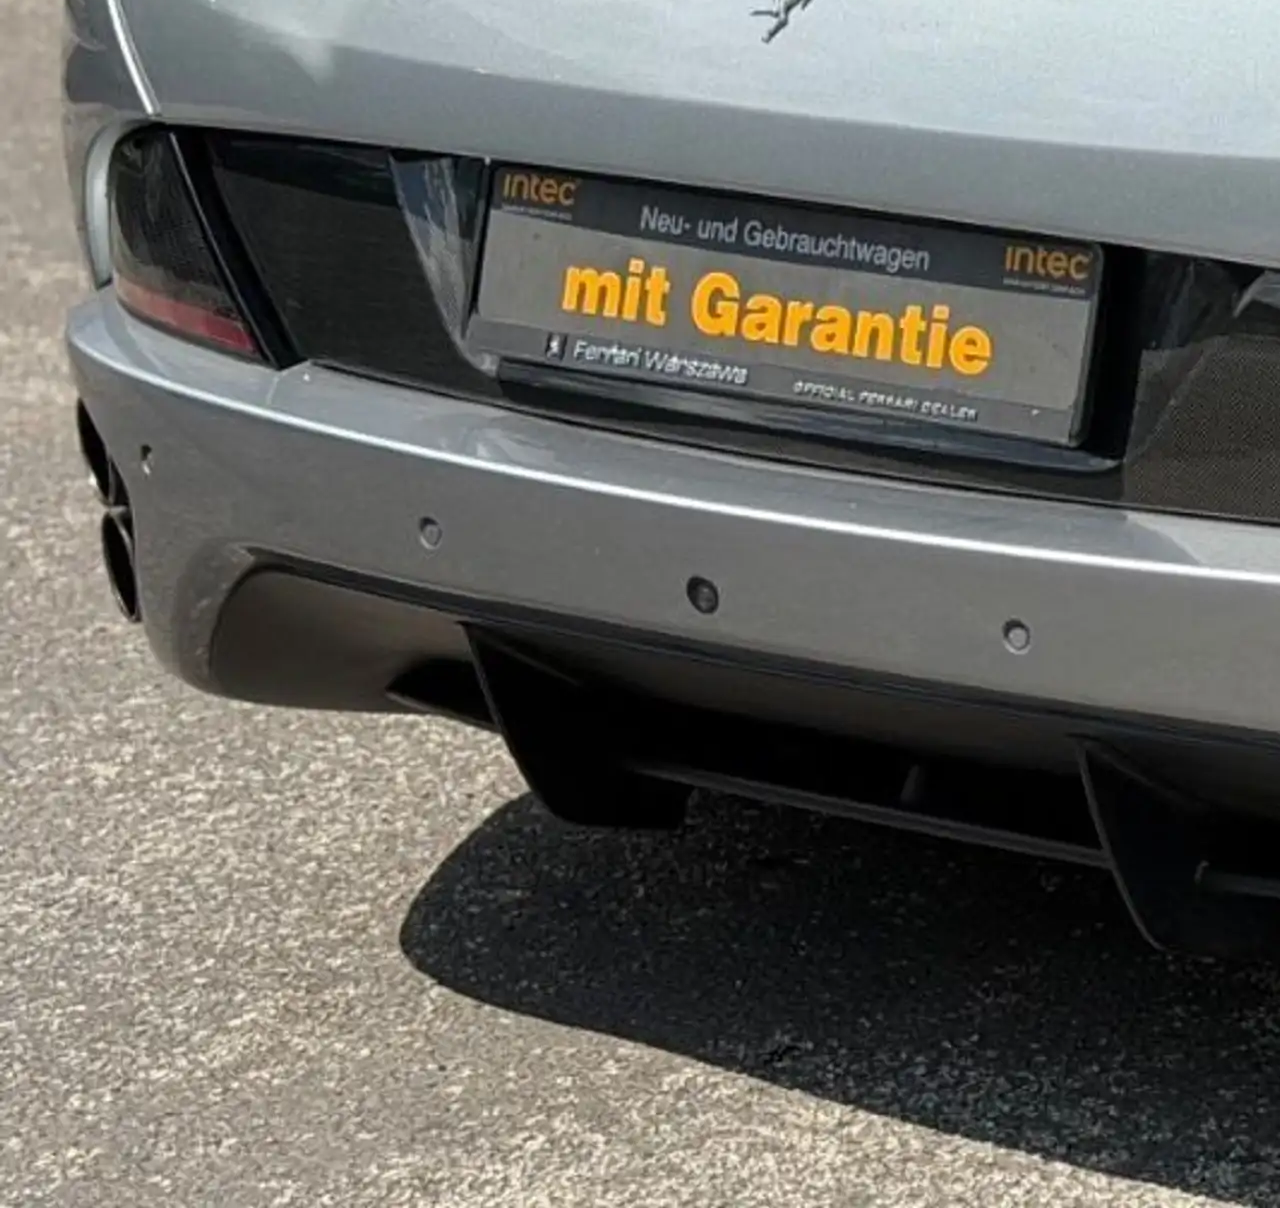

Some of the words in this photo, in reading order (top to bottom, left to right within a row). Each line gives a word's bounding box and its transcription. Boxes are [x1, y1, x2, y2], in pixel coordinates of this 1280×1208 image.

[640, 204, 691, 235] Neu-
[697, 216, 739, 243] und
[743, 219, 931, 274] Gebrauchtwagen
[562, 257, 671, 327] mit
[690, 270, 993, 376] Garantie
[573, 339, 642, 367] Ferrari
[644, 349, 748, 385] Warszawa
